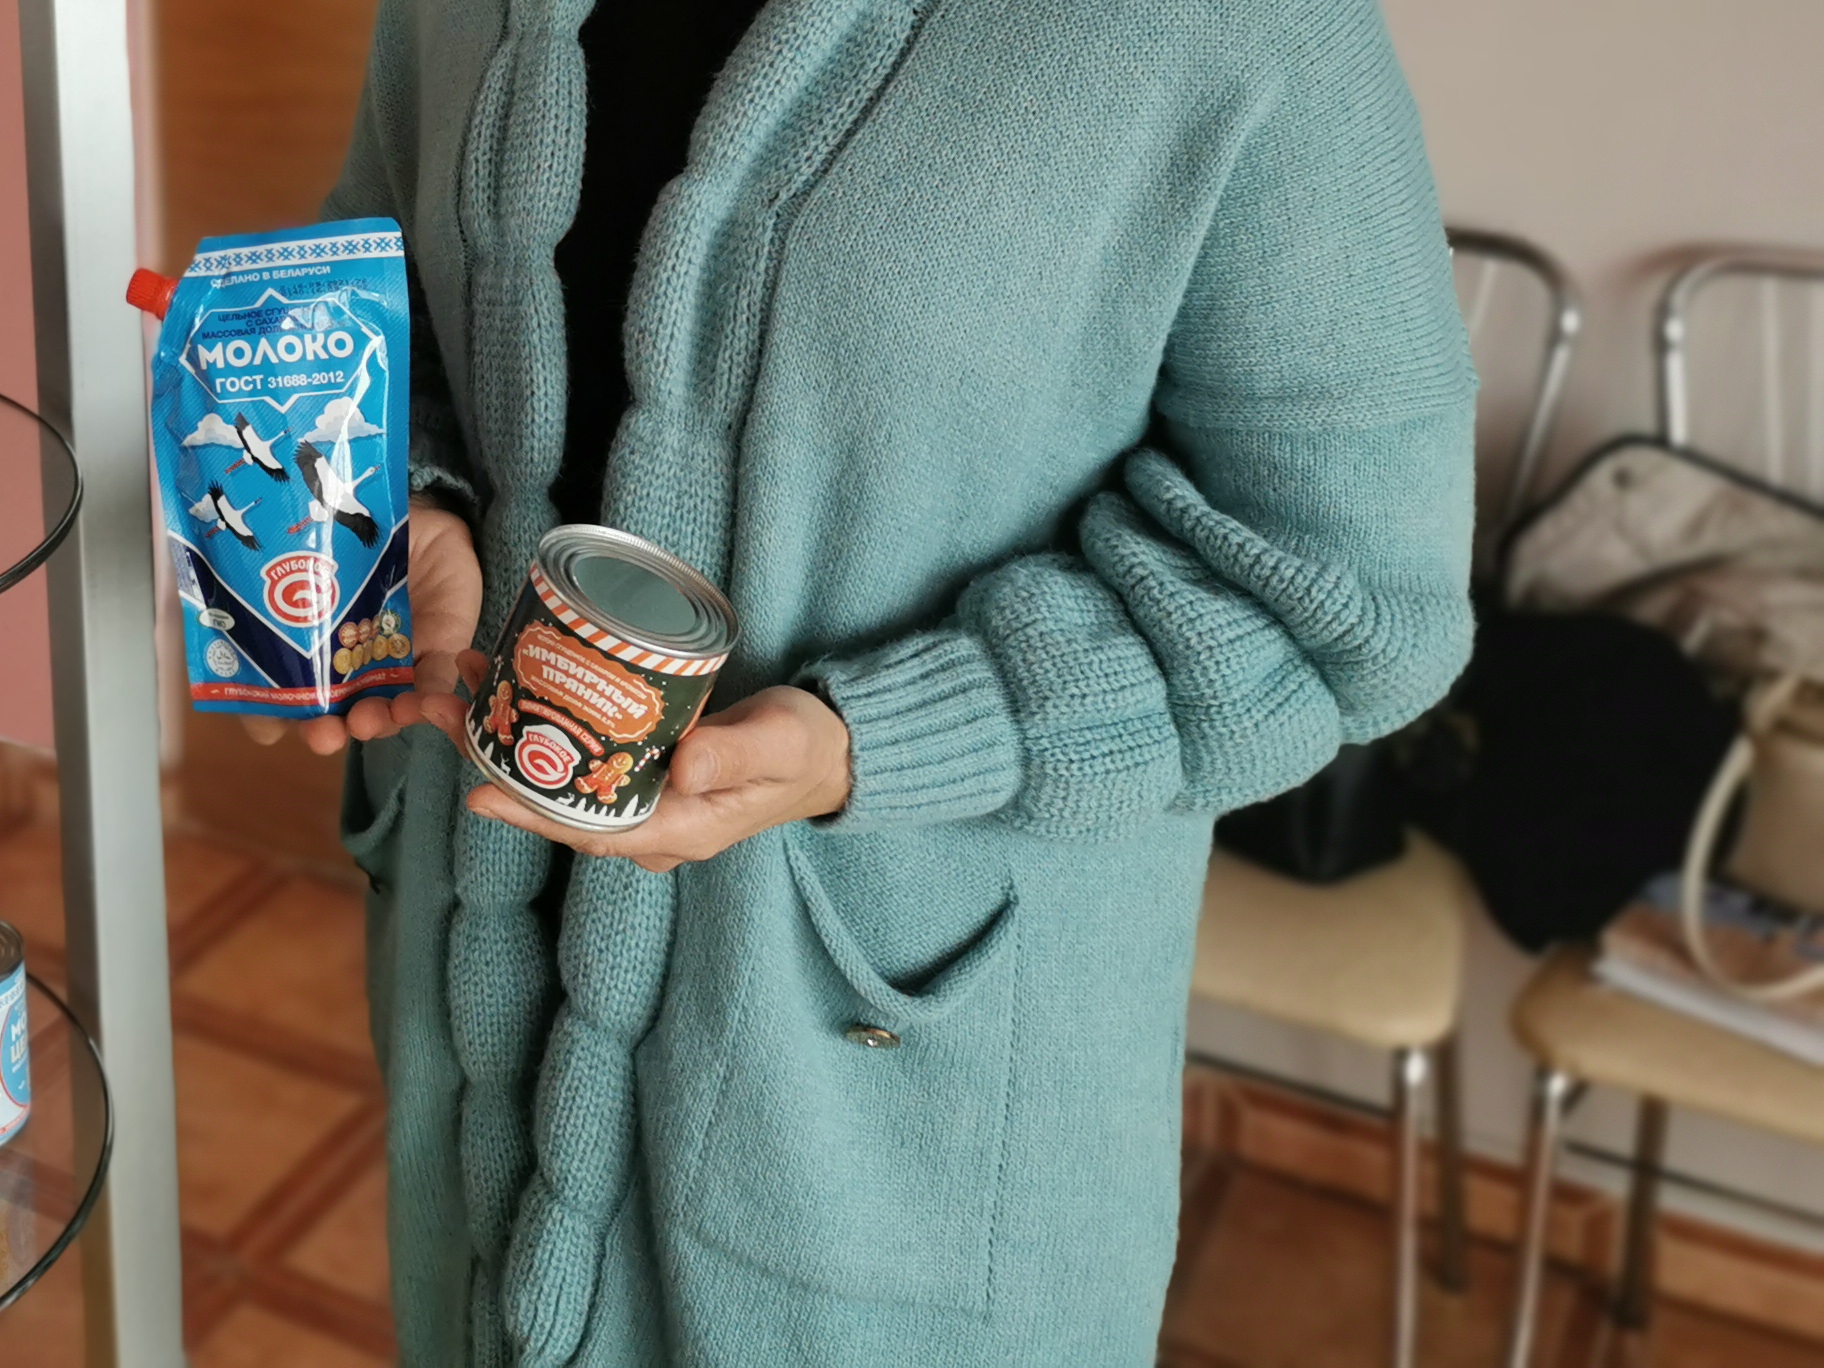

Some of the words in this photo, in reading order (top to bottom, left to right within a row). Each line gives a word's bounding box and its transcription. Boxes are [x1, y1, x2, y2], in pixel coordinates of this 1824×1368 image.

[210, 274, 260, 289] СДЕЛАНО
[273, 266, 331, 280] БЕЛАРУСИ
[218, 311, 262, 323] ЦЕЛЬНОЕ
[202, 328, 256, 341] МАССОВАЯ
[197, 330, 354, 372] МОЛОКО
[215, 374, 264, 394] ГОСТ
[268, 371, 345, 389] 31688-2012
[522, 644, 649, 719] «ИМБИРНЫЙ
[542, 664, 623, 720] ПРЯНИК»
[528, 733, 572, 764] ГЛУБОКОЕ
